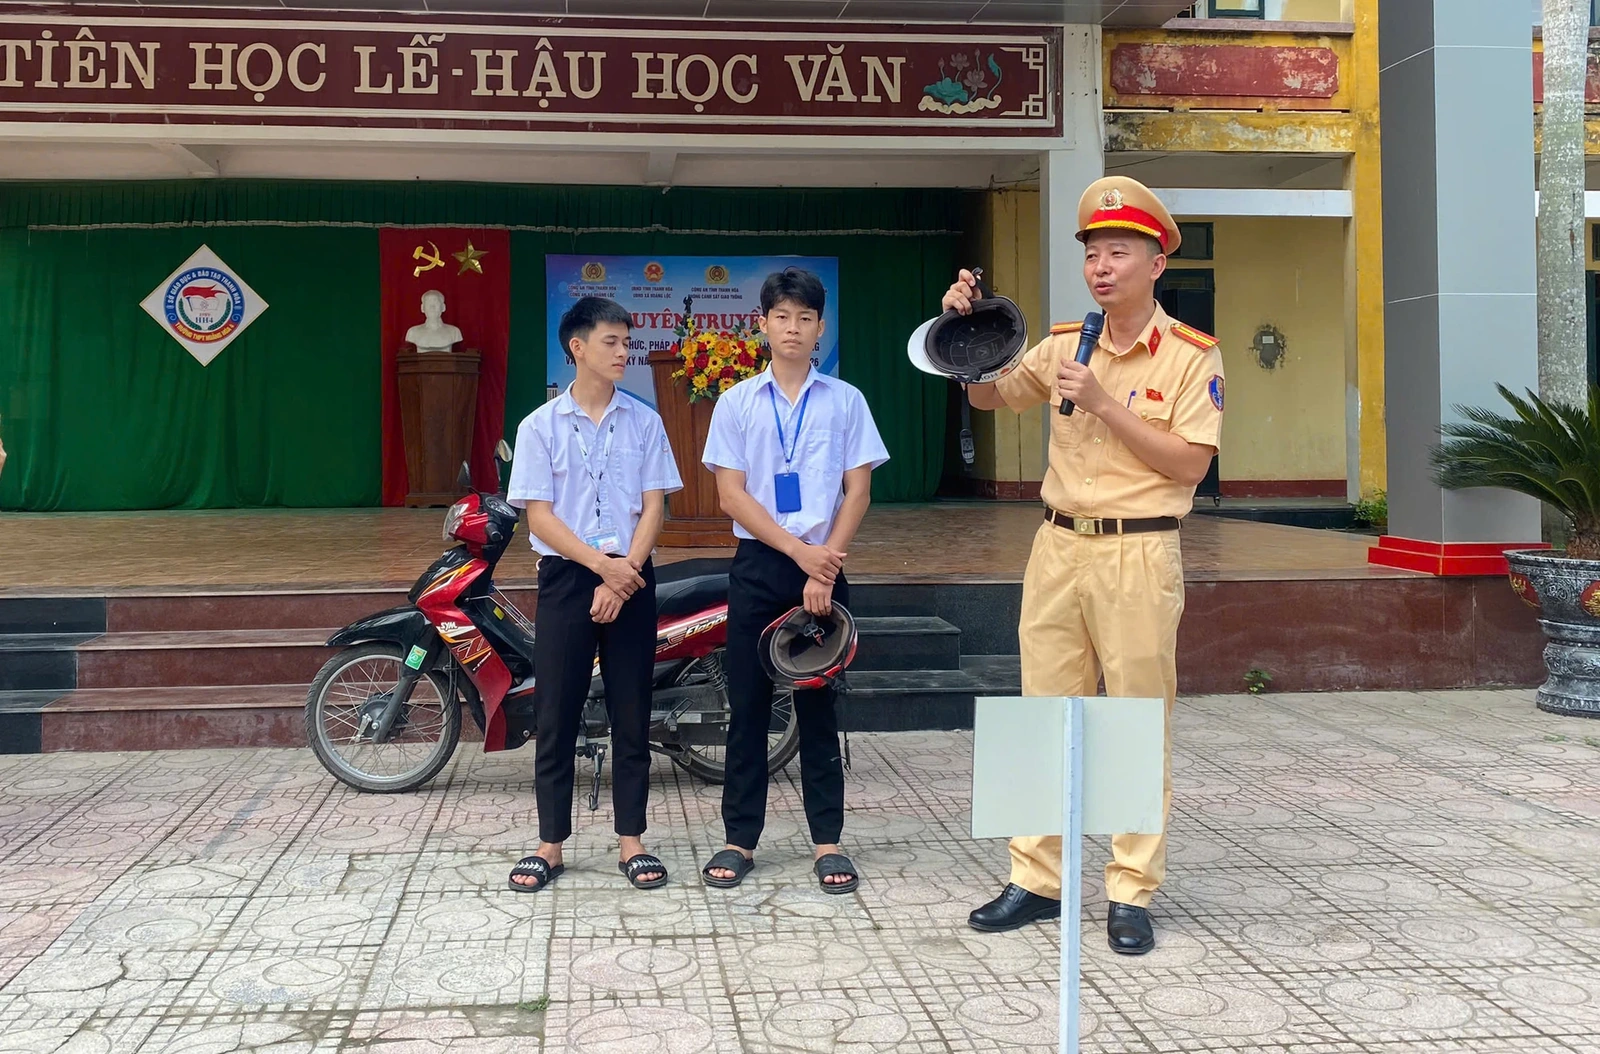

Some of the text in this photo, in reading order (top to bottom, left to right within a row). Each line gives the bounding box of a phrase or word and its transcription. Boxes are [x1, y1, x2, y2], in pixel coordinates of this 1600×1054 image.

[189, 42, 326, 102] HỌC
[353, 32, 446, 94] LỄ
[470, 37, 607, 108] HẬU
[632, 53, 758, 112] HỌC
[784, 43, 906, 103] VĂN
[629, 305, 762, 330] UYÊN TRUYỀ
[628, 340, 646, 350] HỨC,
[440, 621, 458, 630] SYM
